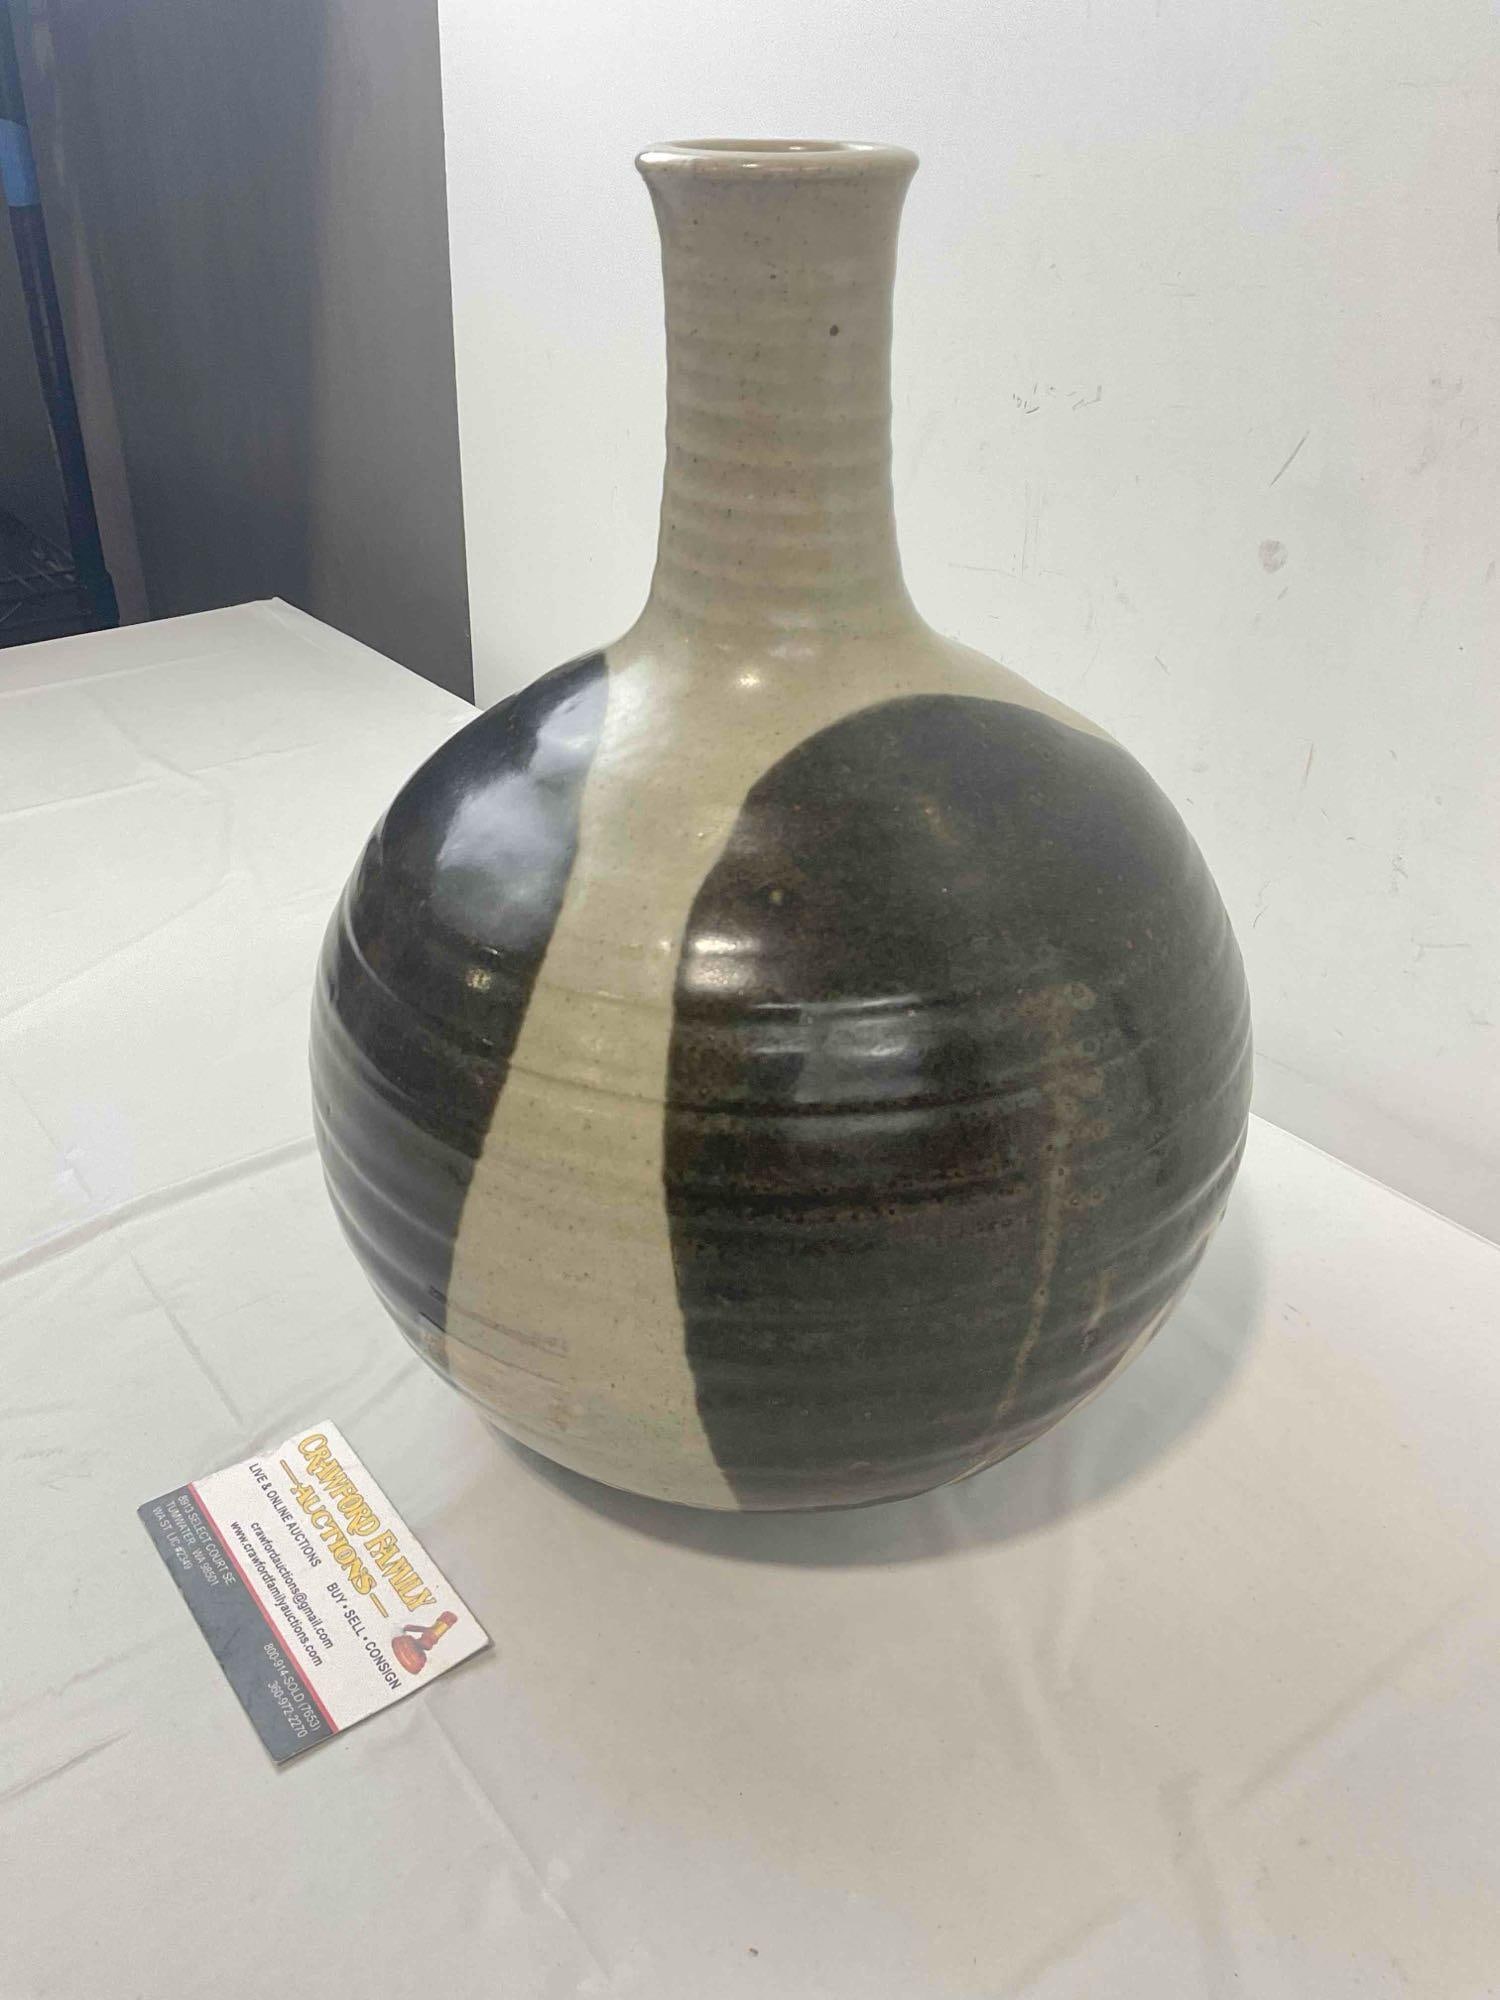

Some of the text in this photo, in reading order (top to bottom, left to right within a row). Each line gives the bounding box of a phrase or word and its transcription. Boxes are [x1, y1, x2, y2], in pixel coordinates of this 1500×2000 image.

[153, 1506, 165, 1521] WA
[159, 1519, 171, 1531] ST
[166, 1532, 180, 1547] LIC
[165, 1500, 219, 1586] TUMWATER WA 98501
[178, 1494, 236, 1585] 8913 SELECT COURT SE
[248, 1463, 321, 1567] LIVE & ONLINE AUCTIONS
[289, 1484, 377, 1594] AUCTIONS
[299, 1432, 436, 1612] CRAWFORD FAMILY
[230, 1521, 323, 1666] www.crawfordfamilyauctions.com
[250, 1521, 333, 1649] crawfordauctions@gmail.com
[326, 1582, 401, 1689] BUY SELL CONSIGN
[263, 1643, 320, 1731] 800-914-SOLD (7653)
[267, 1679, 308, 1738] 360-972-2270
